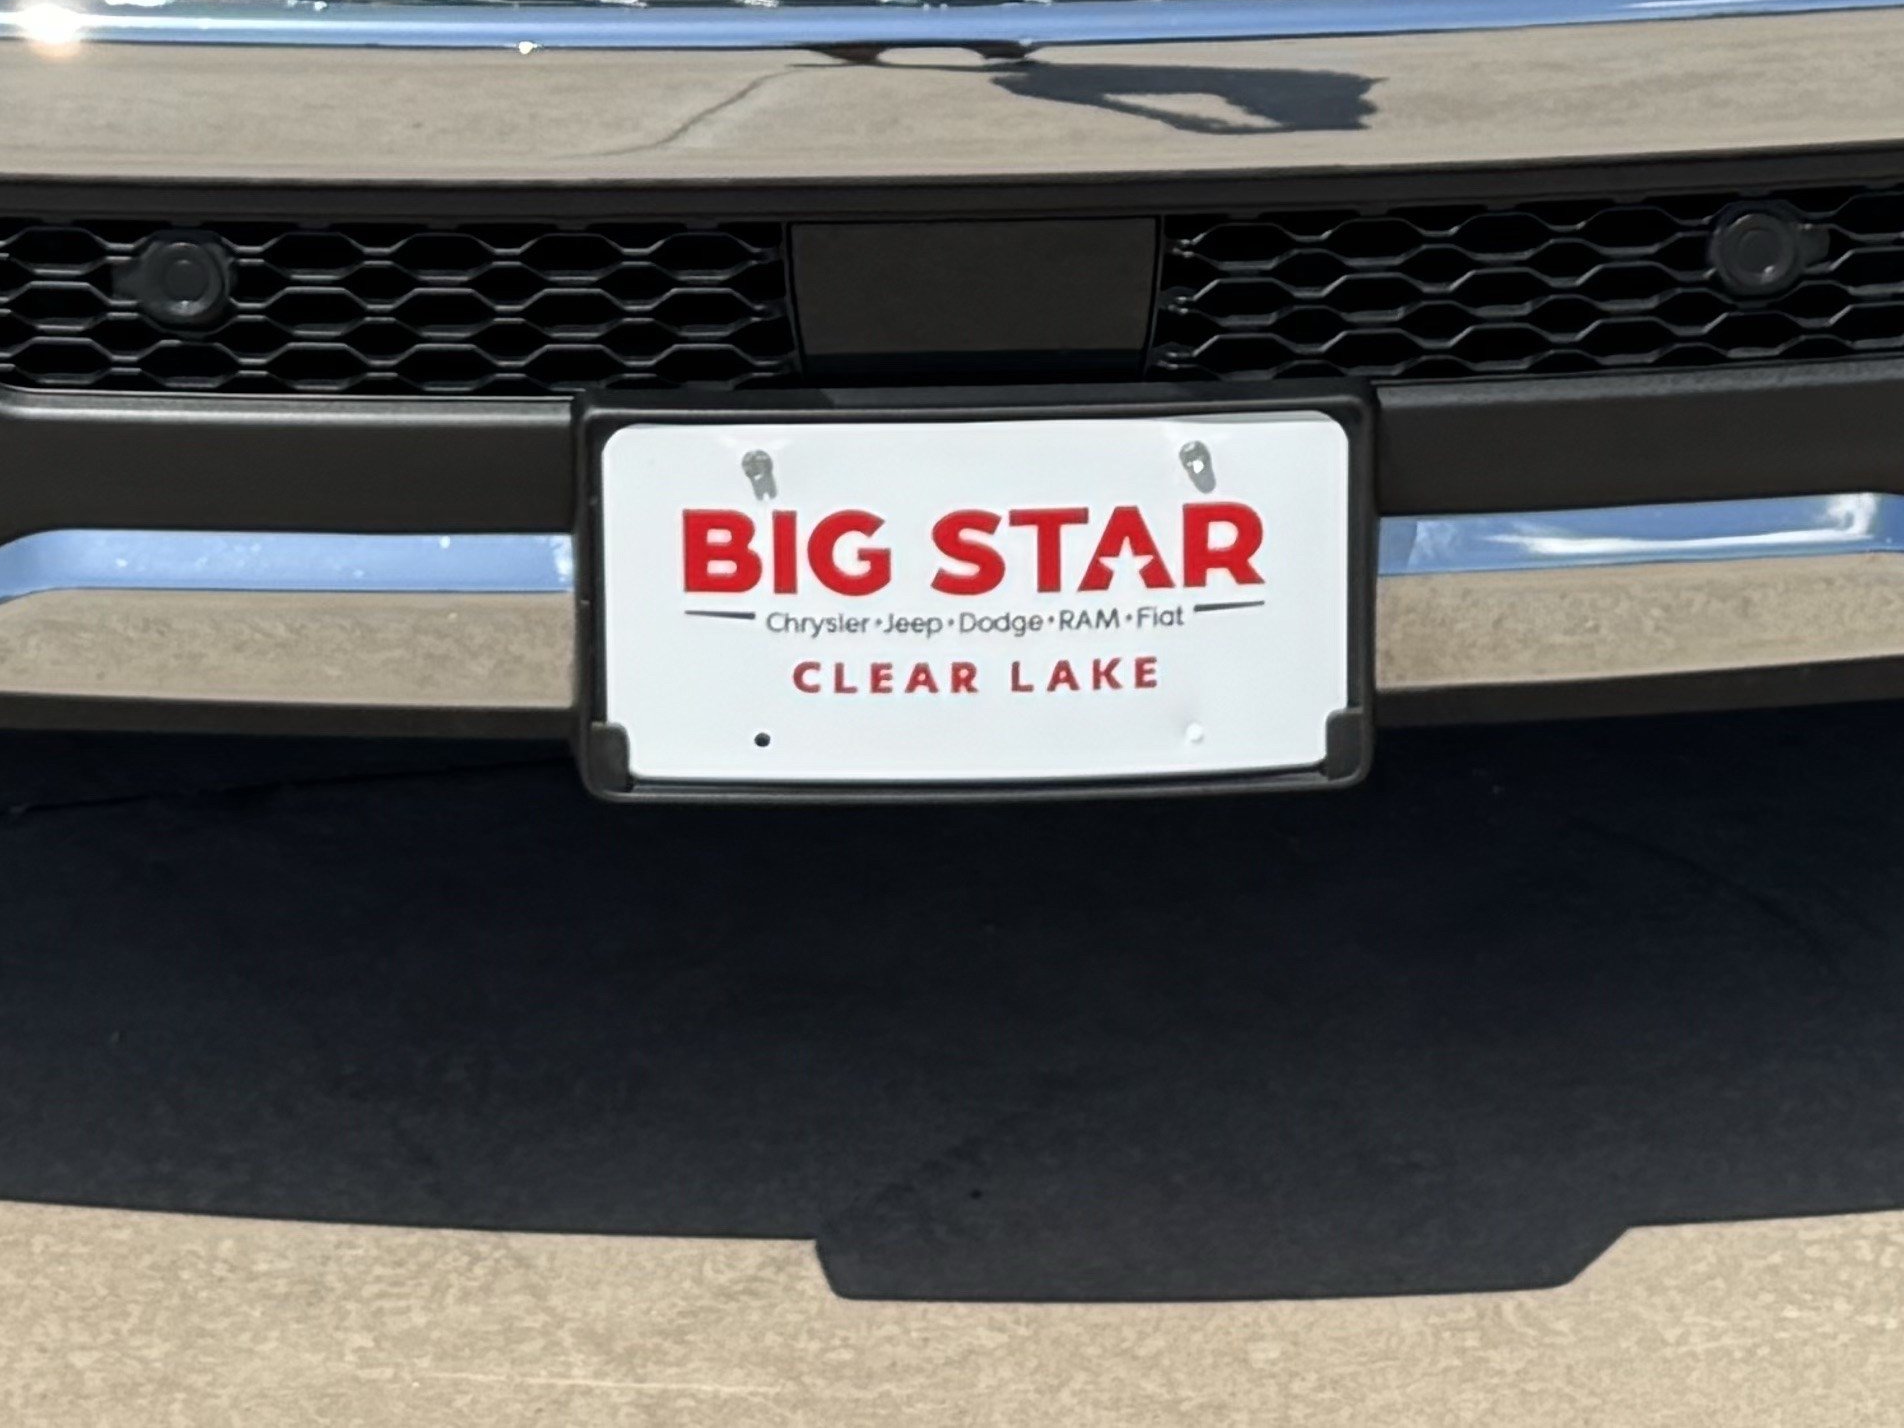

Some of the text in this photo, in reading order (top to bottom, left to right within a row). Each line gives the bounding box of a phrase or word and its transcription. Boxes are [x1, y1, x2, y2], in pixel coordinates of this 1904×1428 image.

[681, 501, 1266, 596] BIG STAR
[765, 604, 1186, 640] Chrysler Jeep Dodge RAM Fiat
[791, 655, 1159, 694] CLEAR LAKE
